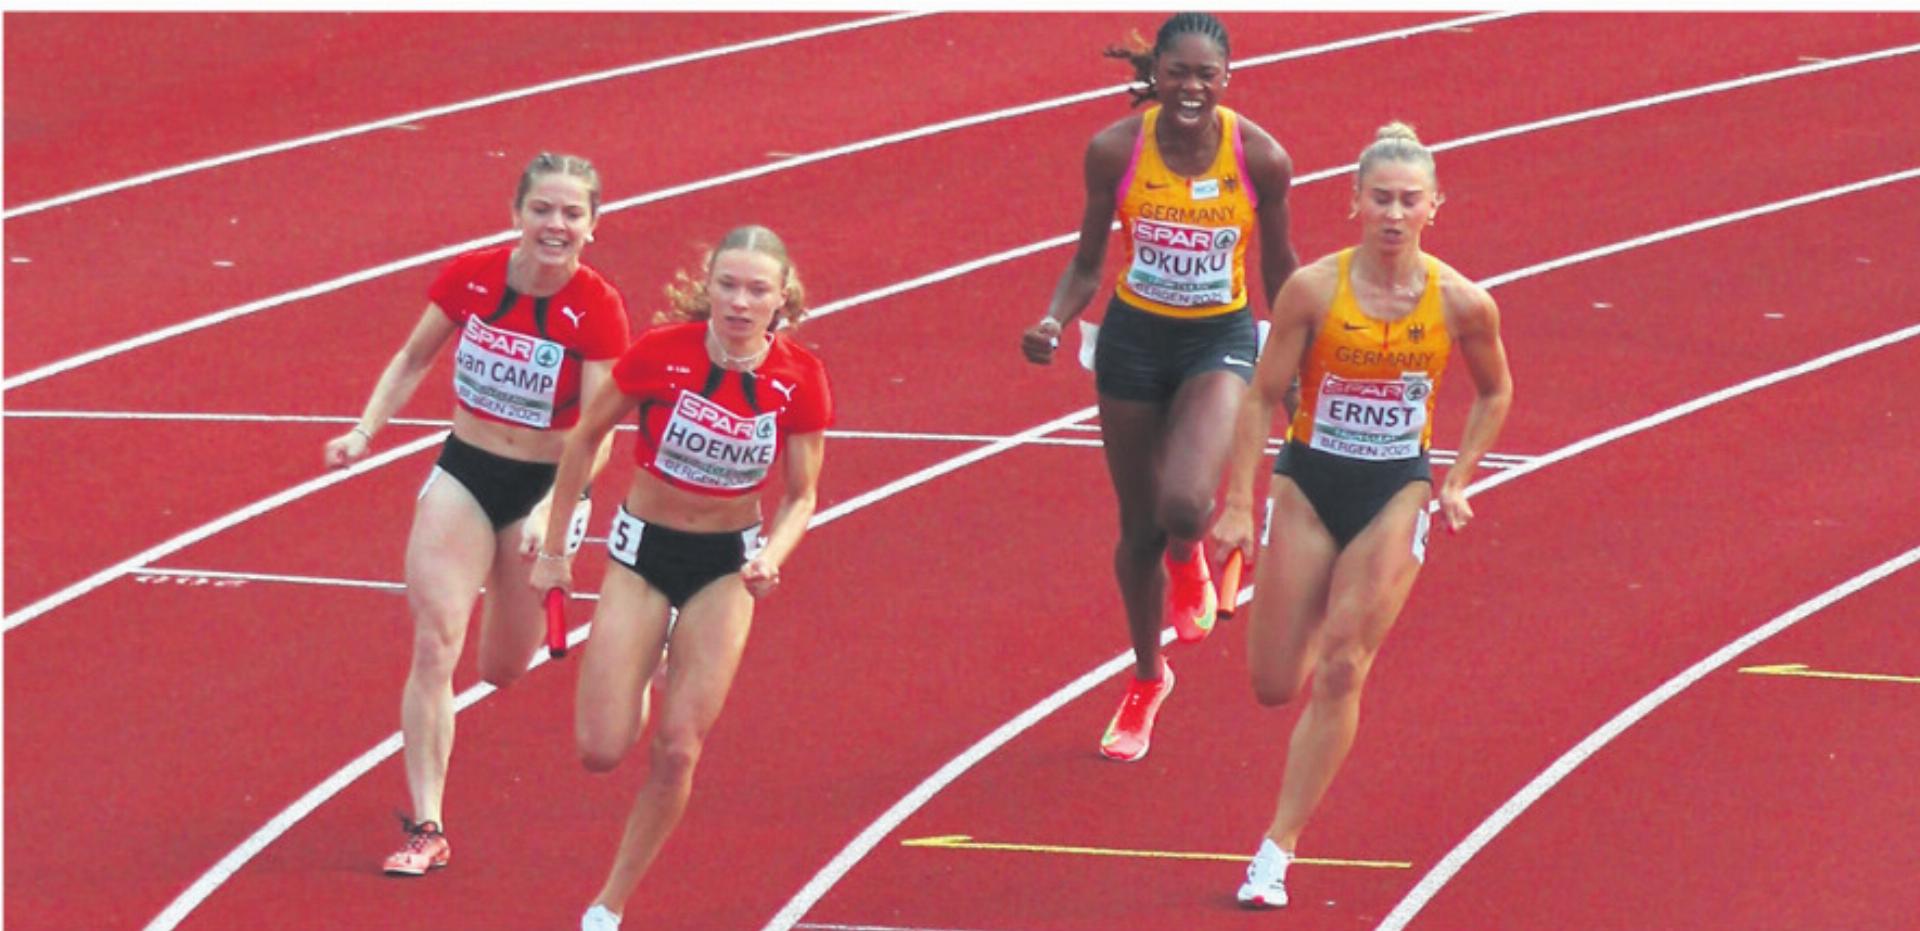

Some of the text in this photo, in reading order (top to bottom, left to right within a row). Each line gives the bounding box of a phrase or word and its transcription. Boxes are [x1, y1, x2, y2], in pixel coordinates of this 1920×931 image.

[1140, 202, 1236, 223] GERMANY
[1136, 222, 1211, 250] SPAR
[1138, 245, 1227, 277] OKUKU
[465, 321, 533, 360] SPAR
[1335, 345, 1436, 367] GERMANY
[490, 361, 554, 394] CAMP
[680, 398, 754, 438] SPAR
[1328, 399, 1417, 428] ERNST
[665, 421, 773, 465] HOENKE
[1320, 436, 1378, 457] BERGEN
[614, 520, 631, 551] 5
